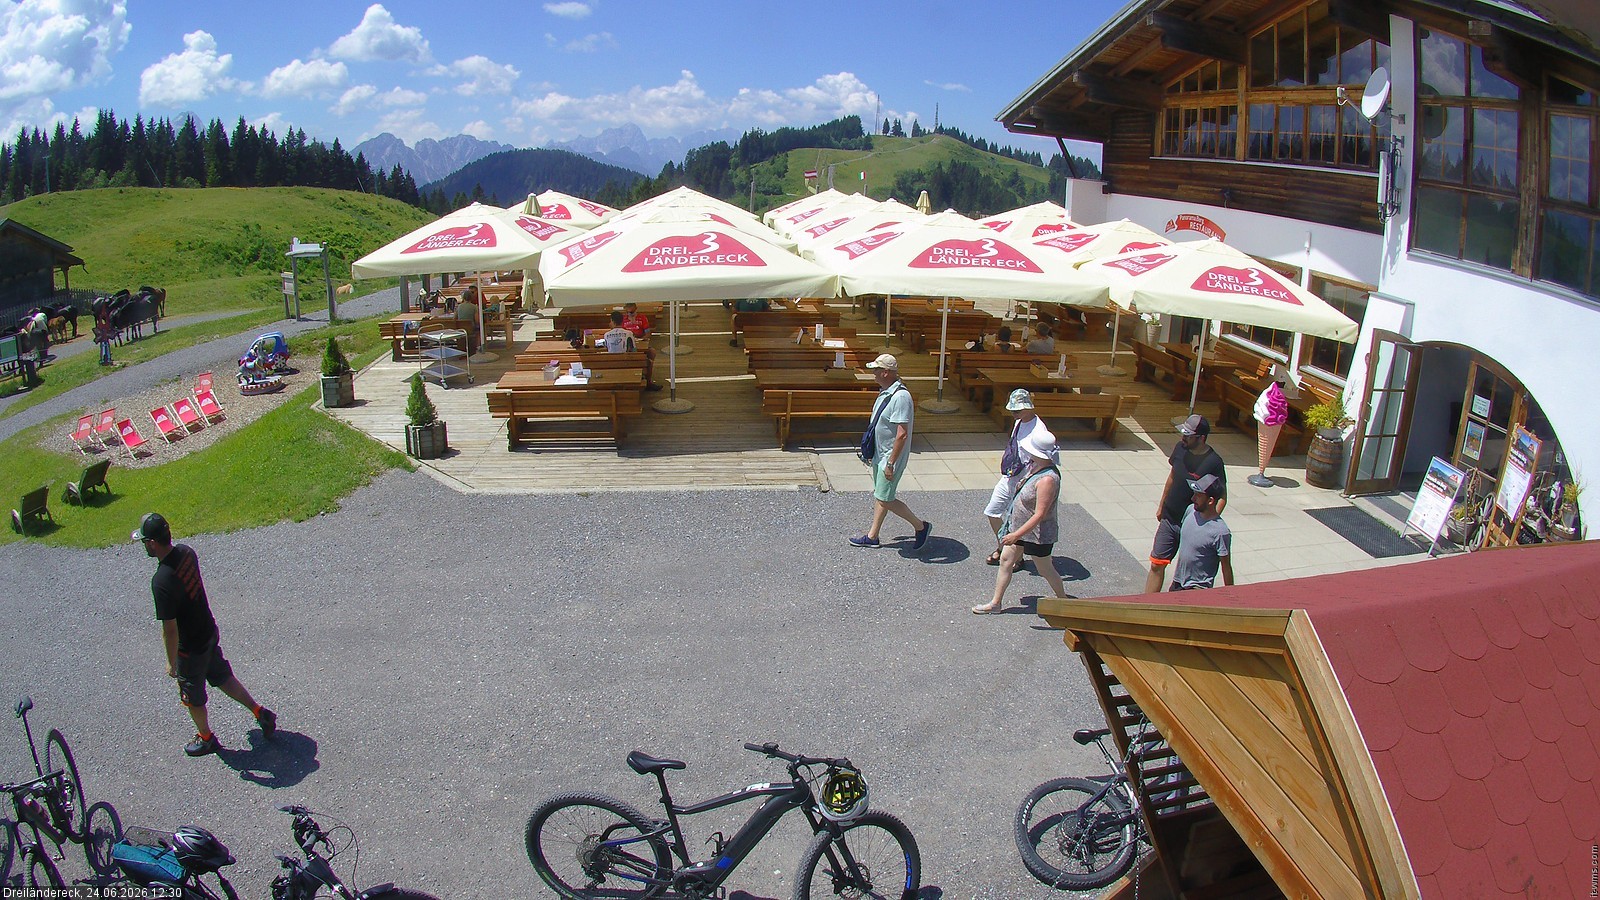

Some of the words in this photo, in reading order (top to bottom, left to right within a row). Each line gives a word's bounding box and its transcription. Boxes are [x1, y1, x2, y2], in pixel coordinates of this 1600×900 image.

[426, 234, 456, 243] DREI.
[649, 246, 693, 256] DREI.
[933, 247, 974, 257] DREI.
[643, 253, 749, 266] LÄNDER.ECK
[928, 254, 1027, 269] LÄNDER.ECK
[1208, 272, 1244, 285] DREI.
[1206, 279, 1290, 300] LÄNDER.ECK
